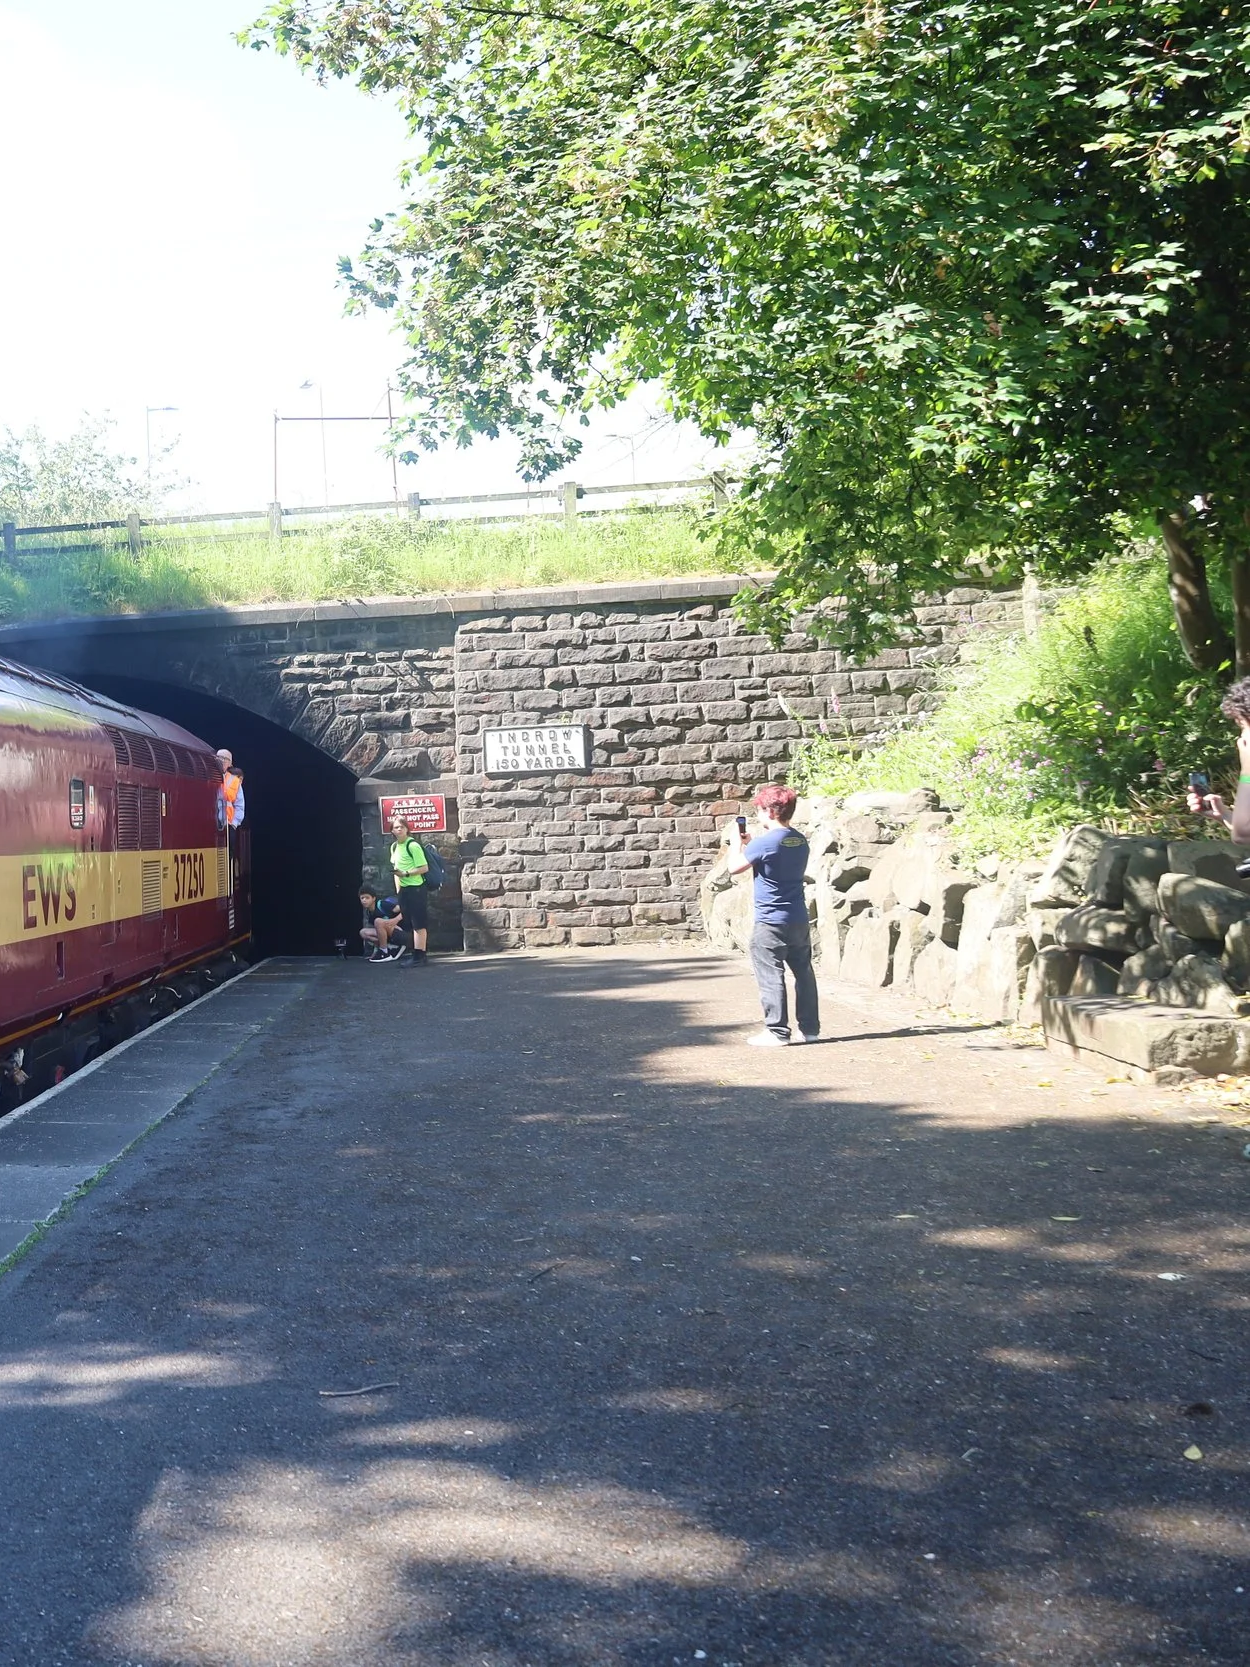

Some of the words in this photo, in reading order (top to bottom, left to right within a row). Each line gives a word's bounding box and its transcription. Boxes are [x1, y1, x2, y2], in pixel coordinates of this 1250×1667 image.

[496, 759, 520, 770] 150
[524, 756, 577, 769] YARDS
[501, 743, 572, 756] TUNNEL
[174, 852, 205, 902] 37250
[22, 863, 77, 930] EWS
